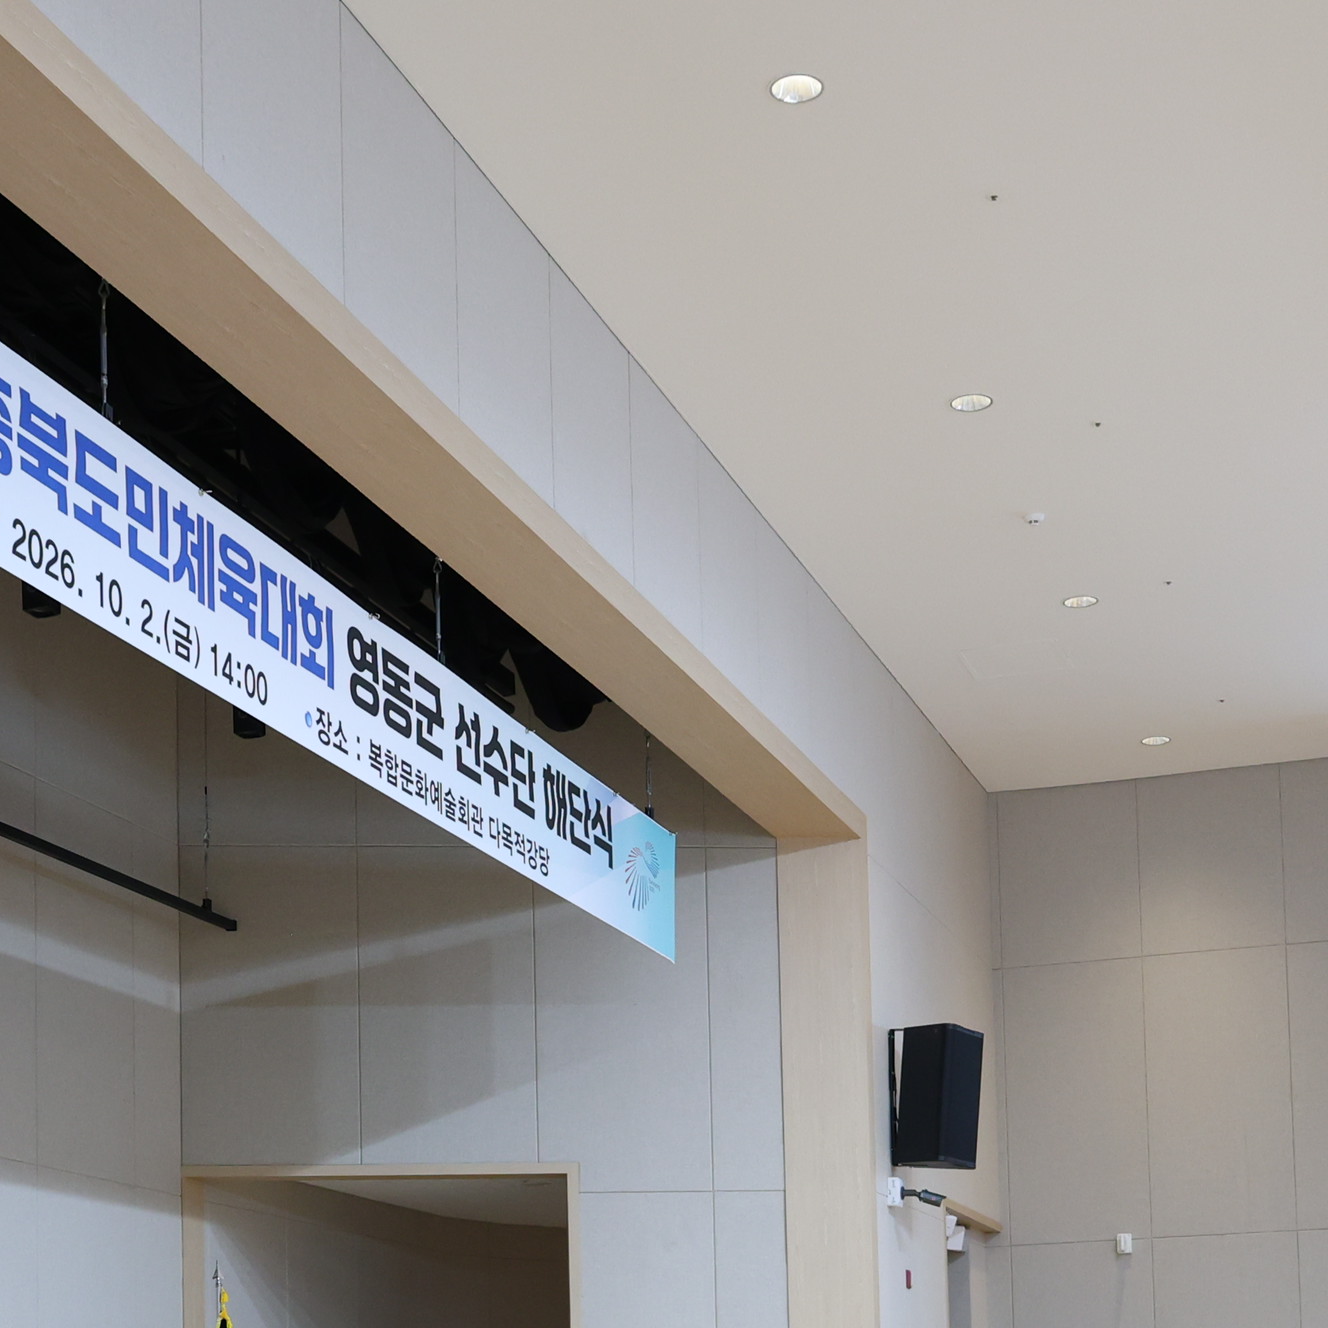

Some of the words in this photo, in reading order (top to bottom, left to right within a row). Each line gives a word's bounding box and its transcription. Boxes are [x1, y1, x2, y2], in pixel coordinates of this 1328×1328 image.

[12, 518, 83, 598] 2026.
[95, 572, 130, 626] 10.
[141, 599, 201, 669] 2.(금)
[210, 644, 269, 706] 14:00
[315, 707, 349, 755] 장소
[369, 738, 483, 838] 복합문화예술회관
[488, 816, 550, 877] 다목적강당
[347, 626, 445, 761] 영동군
[455, 702, 535, 820] 선수단
[543, 762, 613, 870] 해단식
